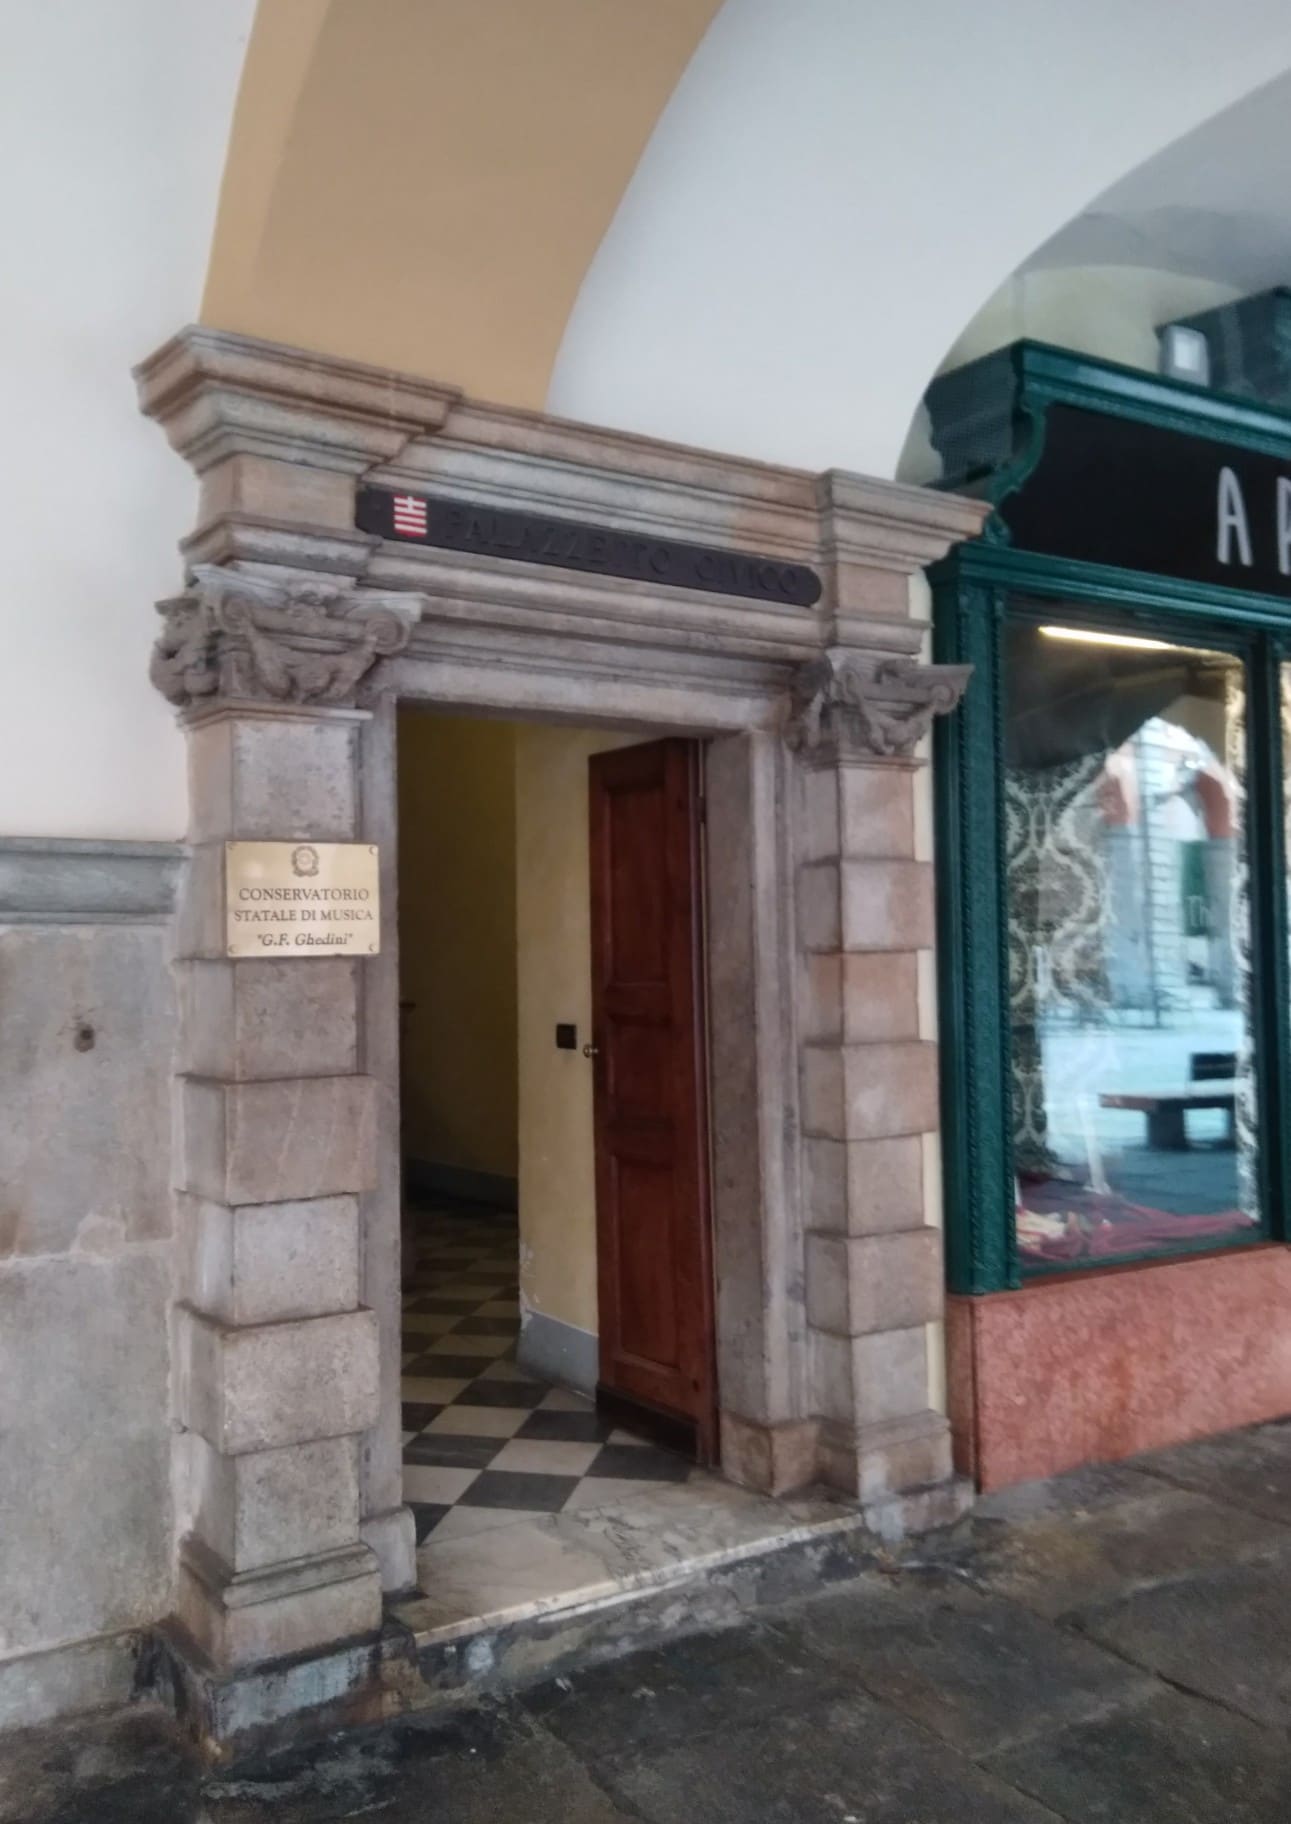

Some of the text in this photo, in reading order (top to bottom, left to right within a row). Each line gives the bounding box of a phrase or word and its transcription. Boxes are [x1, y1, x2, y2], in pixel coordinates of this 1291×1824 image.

[239, 887, 369, 901] CONSERVATORIO
[234, 909, 373, 922] STATALE DI MUSICA
